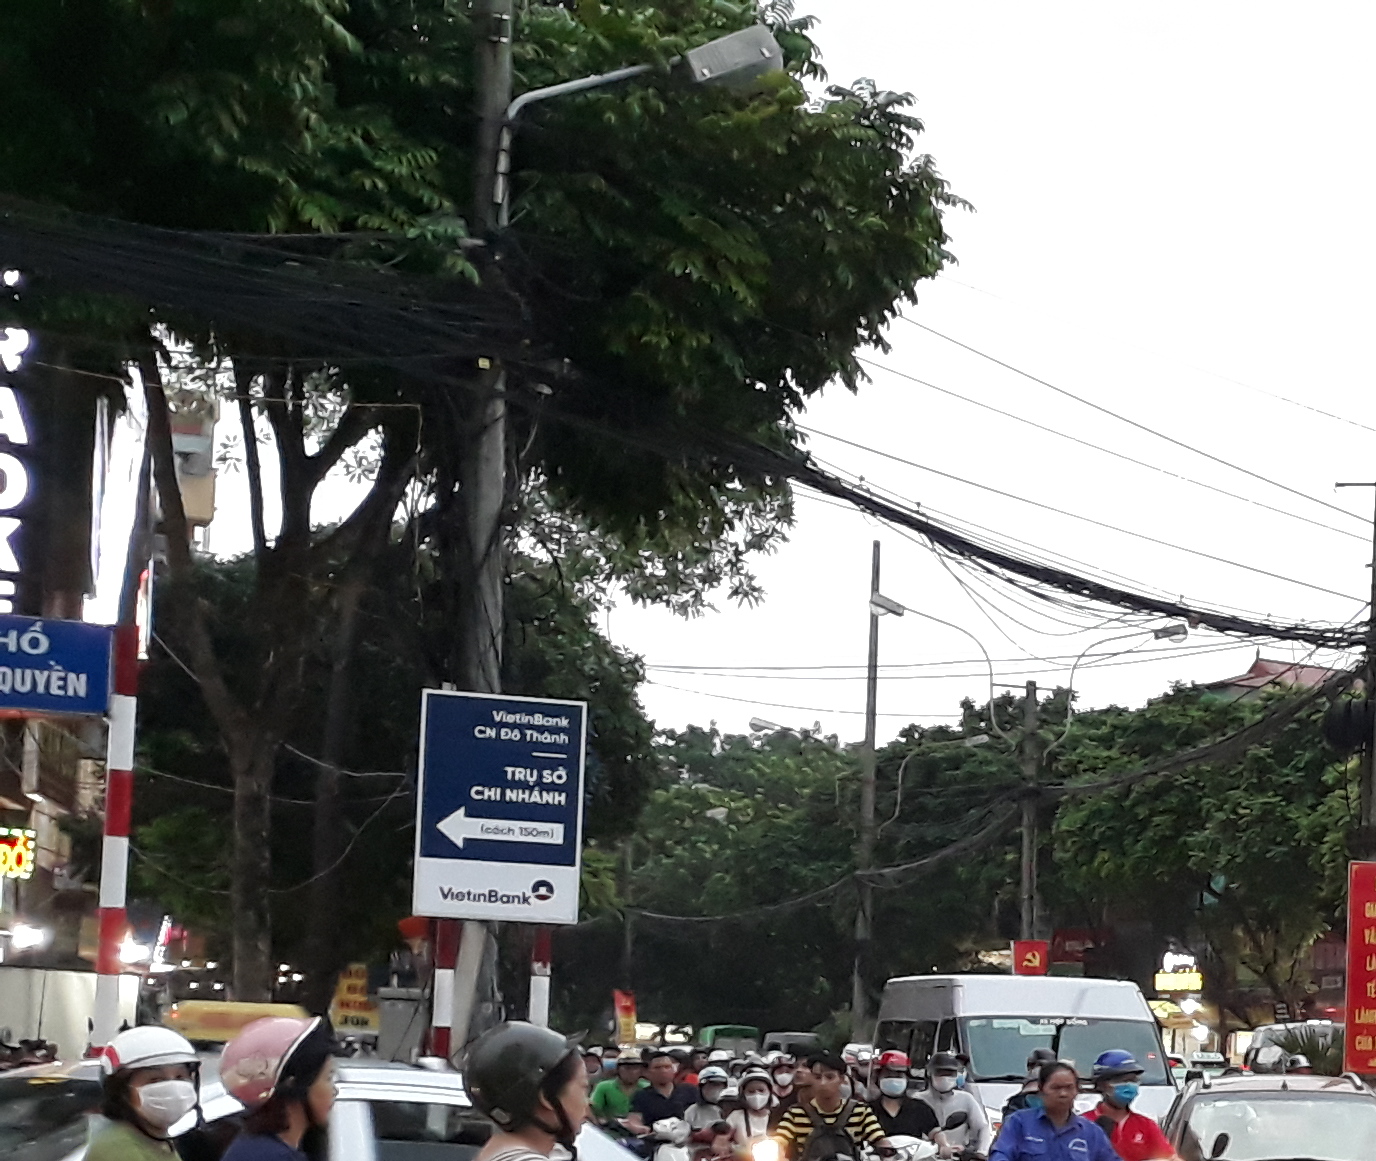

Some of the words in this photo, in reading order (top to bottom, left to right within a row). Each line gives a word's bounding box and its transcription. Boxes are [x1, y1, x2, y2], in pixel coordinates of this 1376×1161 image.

[492, 710, 570, 728] VietinBank
[474, 726, 496, 740] CN
[504, 766, 538, 786] TRỤ
[542, 766, 568, 785] SỞ
[470, 786, 501, 801] CHI
[505, 786, 567, 806] NHÁNH
[439, 886, 532, 906] VietinBank
